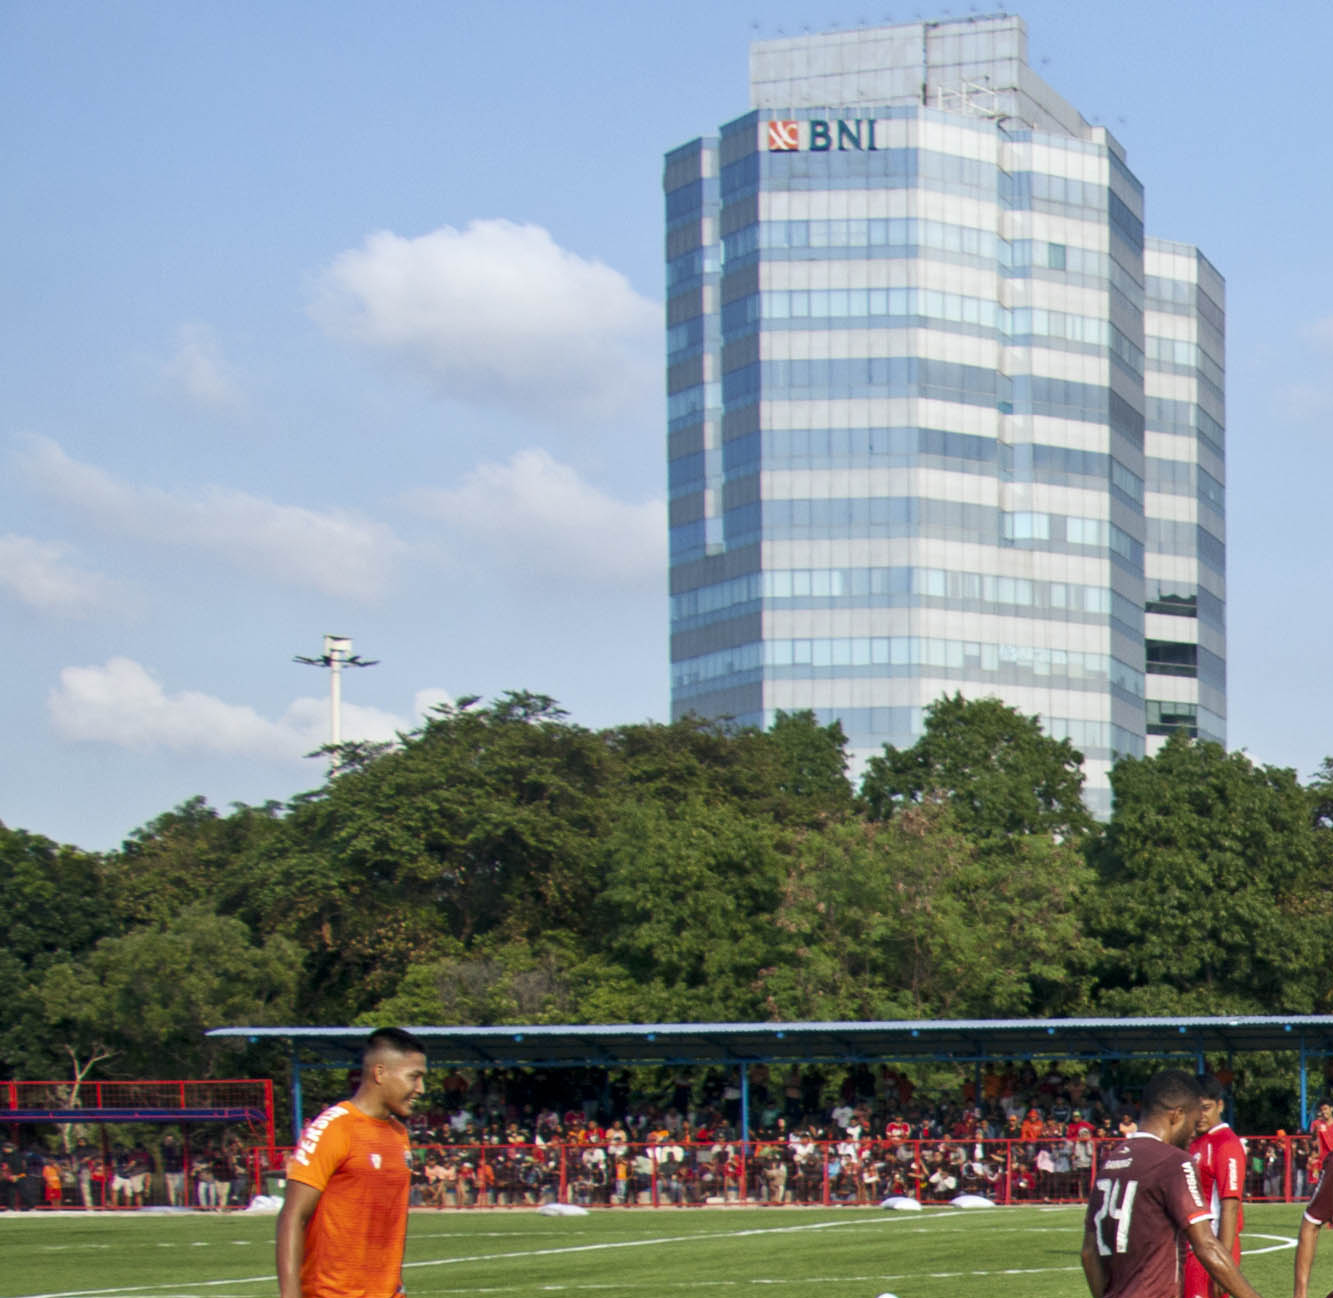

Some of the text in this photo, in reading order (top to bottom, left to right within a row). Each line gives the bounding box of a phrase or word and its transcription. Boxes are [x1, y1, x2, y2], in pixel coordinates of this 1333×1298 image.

[809, 119, 878, 151] BNI
[1181, 1161, 1204, 1208] PERSIJA
[1094, 1177, 1138, 1256] 24
